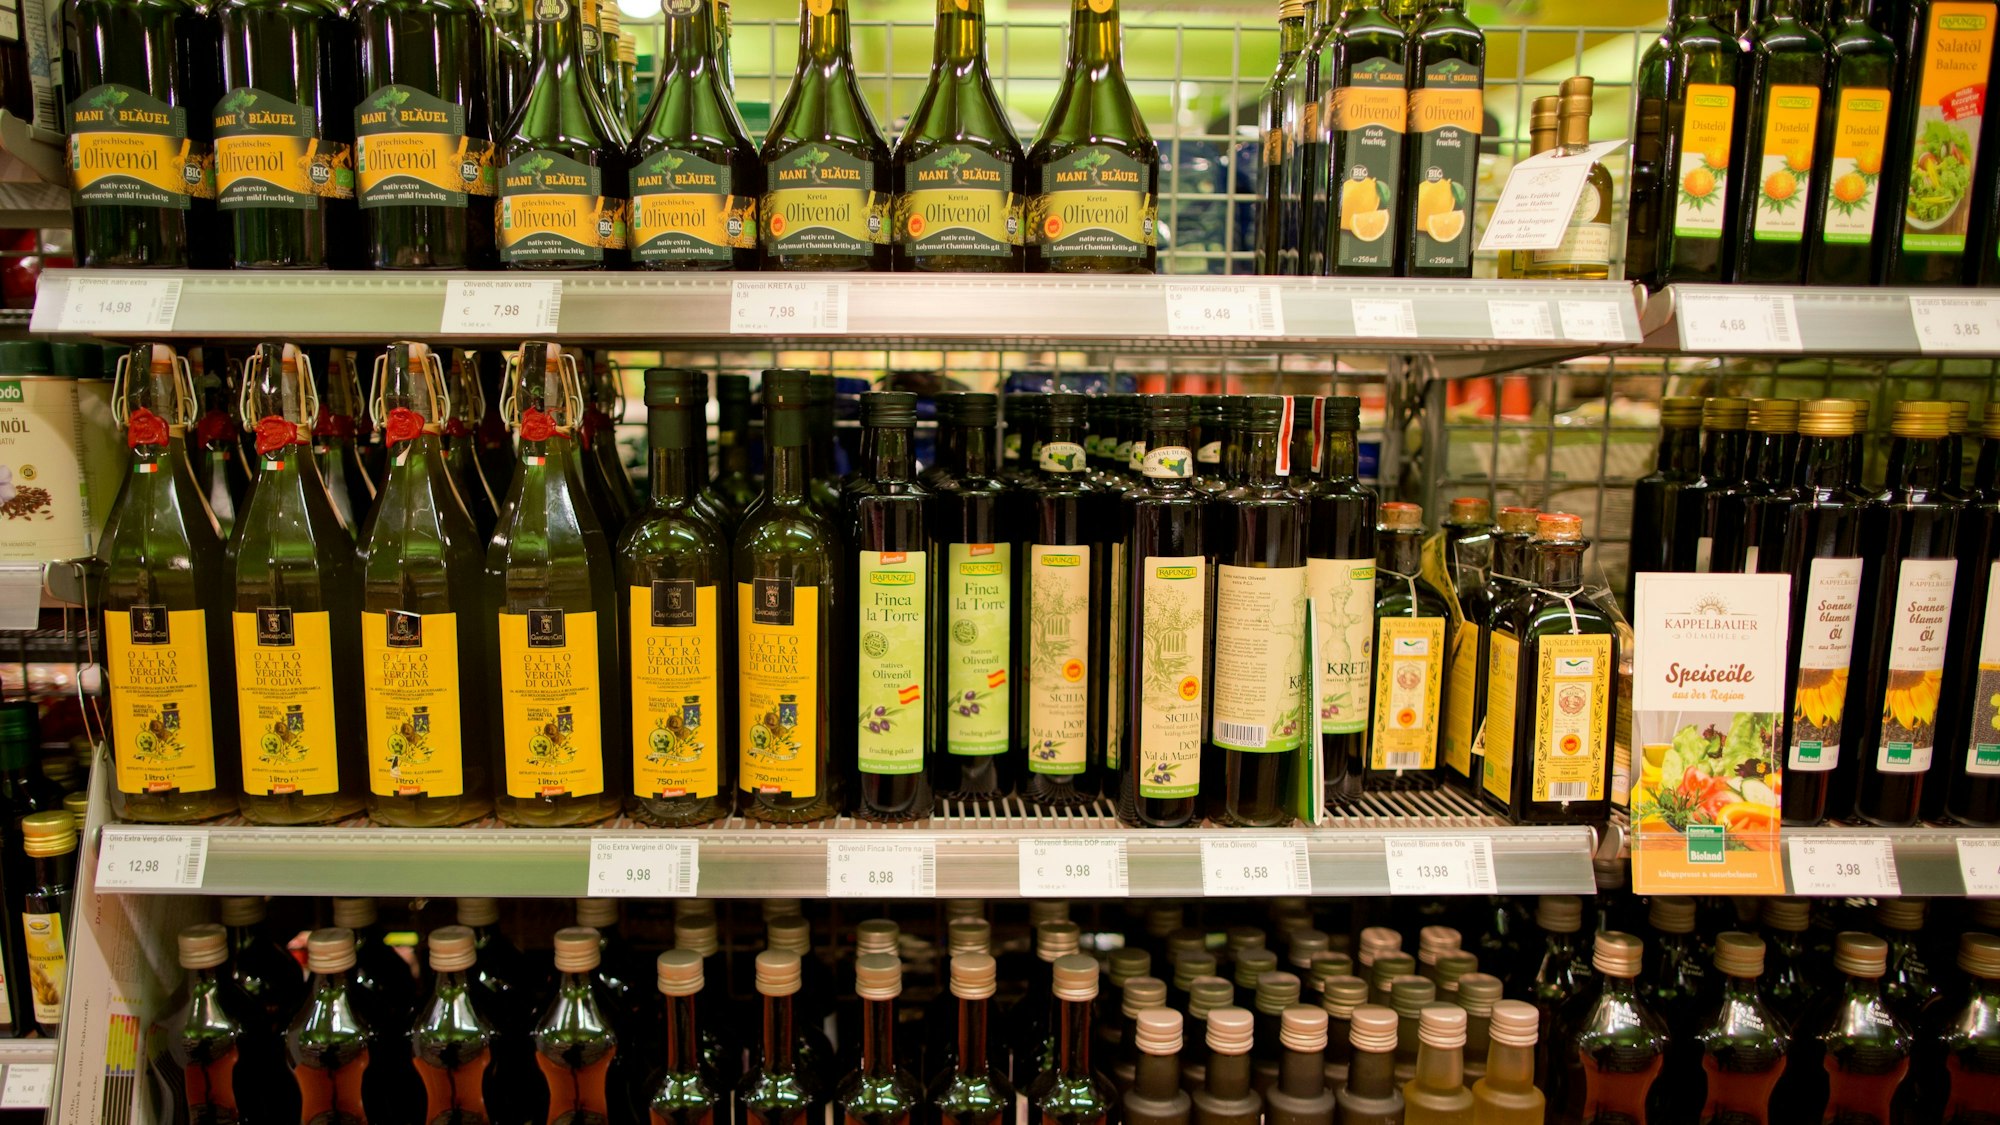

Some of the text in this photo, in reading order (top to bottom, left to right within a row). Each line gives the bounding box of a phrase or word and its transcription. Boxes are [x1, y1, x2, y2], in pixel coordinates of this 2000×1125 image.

[1936, 39, 1981, 53] Salatöl
[1936, 60, 1977, 70] Balance
[76, 108, 170, 125] MANI BLÄUEL
[216, 111, 296, 127] MANI BLÄUEL
[362, 108, 448, 125] MANI BLÄUEL
[1692, 120, 1726, 131] Distelöl
[1775, 122, 1810, 133] Distelöl
[1845, 125, 1880, 136] Distelöl
[1365, 129, 1383, 137] frisch
[1440, 130, 1458, 138] frisch
[93, 137, 144, 146] griechisches
[1362, 138, 1386, 147] fruchtig
[1436, 139, 1461, 148] fruchtig
[85, 148, 158, 170] Olivenöl
[222, 150, 284, 173] Olivenöl
[370, 149, 437, 171] Olivenöl
[780, 167, 861, 180] MANI BLÄUEL
[919, 168, 1000, 181] MANI BLÄUEL
[1057, 169, 1139, 182] MANI BLÄUEL
[507, 173, 587, 187] MANI BLÄUEL
[638, 172, 717, 187] MANI BLÄUEL
[100, 182, 119, 190] nativ
[383, 183, 399, 191] nativ
[136, 192, 169, 202] fruchtig
[415, 192, 447, 202] fruchtig
[786, 203, 850, 222] Olivenöl
[926, 203, 990, 223] Olivenöl
[1064, 204, 1128, 224] Olivenöl
[514, 209, 577, 228] Olivenöl
[644, 209, 705, 228] Olivenöl
[99, 302, 131, 313] 14,98
[494, 305, 520, 317] 7,98
[769, 306, 796, 318] 7,98
[1204, 309, 1231, 320] 8,48
[1720, 320, 1746, 332] 4,68
[1954, 324, 1981, 336] 3,85
[872, 573, 914, 583] RAPUNZEL
[965, 583, 999, 596] Finca
[875, 593, 912, 606] Finca
[956, 597, 1006, 610] la Torre
[866, 608, 919, 622] la Torre
[1820, 612, 1850, 622] blumen
[1909, 614, 1943, 624] blumen
[1665, 619, 1758, 631] KAPPELBAUER
[1829, 624, 1843, 640] Öl
[1920, 626, 1935, 642] Öl
[647, 637, 701, 647] OLIO
[749, 634, 798, 645] OLIO
[128, 650, 177, 660] OLIO
[648, 647, 701, 656] EXTRA
[750, 644, 798, 655] EXTRA
[254, 652, 301, 661] OLIO
[383, 653, 428, 662] OLIO
[524, 654, 572, 663] OLIO
[648, 656, 701, 666] VERGINE
[750, 652, 798, 664] VERGINE
[962, 656, 999, 665] Olivenöl
[129, 660, 177, 668] EXTRA
[255, 661, 301, 669] EXTRA
[384, 662, 428, 671] EXTRA
[525, 663, 572, 671] EXTRA
[750, 661, 798, 674] DI OLIVA
[1327, 661, 1370, 676] KRETA
[130, 667, 178, 676] VERGINE
[256, 669, 302, 678] VERGINE
[384, 670, 429, 679] VERGINE
[525, 671, 572, 679] VERGINE
[648, 666, 701, 676] DI OLIVA
[872, 670, 912, 679] Olivenöl
[1666, 662, 1755, 688] Speiseöle
[131, 676, 178, 684] DI OLIVA
[271, 678, 302, 686] OLIVA
[384, 679, 429, 688] DI OLIVA
[526, 680, 572, 688] DI OLIVA
[1050, 693, 1085, 703] SICILIA
[1672, 689, 1745, 702] aus der Region
[1165, 713, 1200, 723] SICILIA
[1064, 720, 1084, 729] DOP
[1032, 728, 1084, 739] Val di Mazara
[1180, 740, 1199, 751] DOP
[1145, 751, 1198, 761] Val di Mazara
[632, 844, 656, 852] Vergine
[1230, 841, 1257, 849] Olivenöl
[1691, 851, 1722, 861] Bioland
[129, 860, 159, 874] 12,98
[1066, 865, 1090, 878] 9,98
[1417, 866, 1449, 879] 13,98
[1837, 864, 1861, 877] 3,98
[627, 869, 651, 883] 9,98
[869, 871, 894, 885] 8,98
[1244, 867, 1268, 880] 8,58
